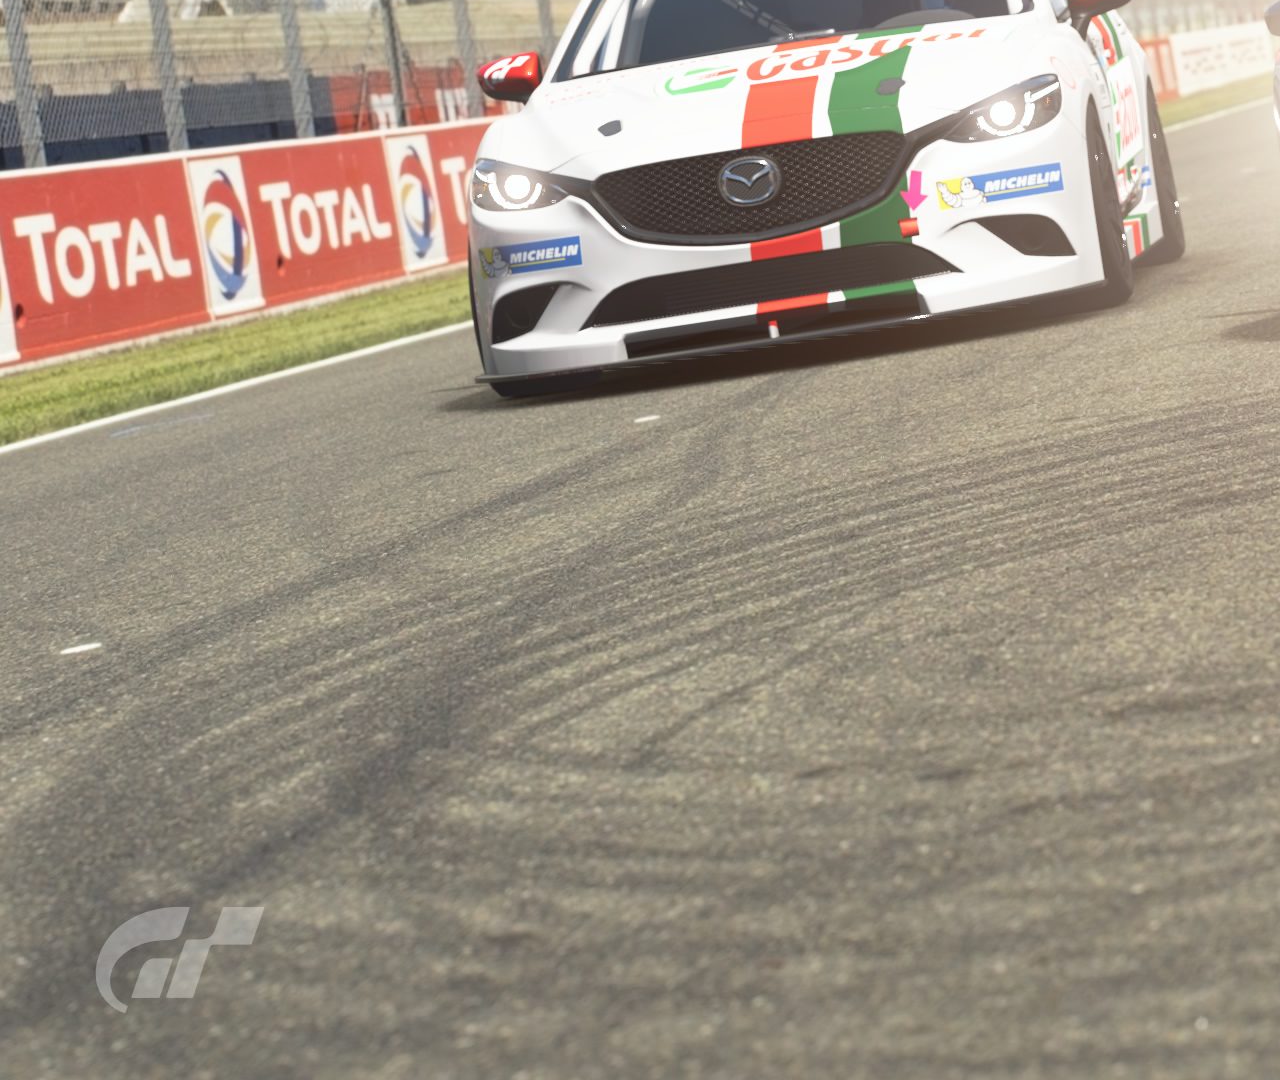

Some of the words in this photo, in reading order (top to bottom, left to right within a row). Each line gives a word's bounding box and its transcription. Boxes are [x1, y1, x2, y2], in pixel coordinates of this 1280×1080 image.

[984, 170, 1061, 194] MICHELIN
[259, 181, 392, 260] TOTAL
[13, 212, 192, 305] TOTAL
[509, 244, 579, 264] MICHELIN
